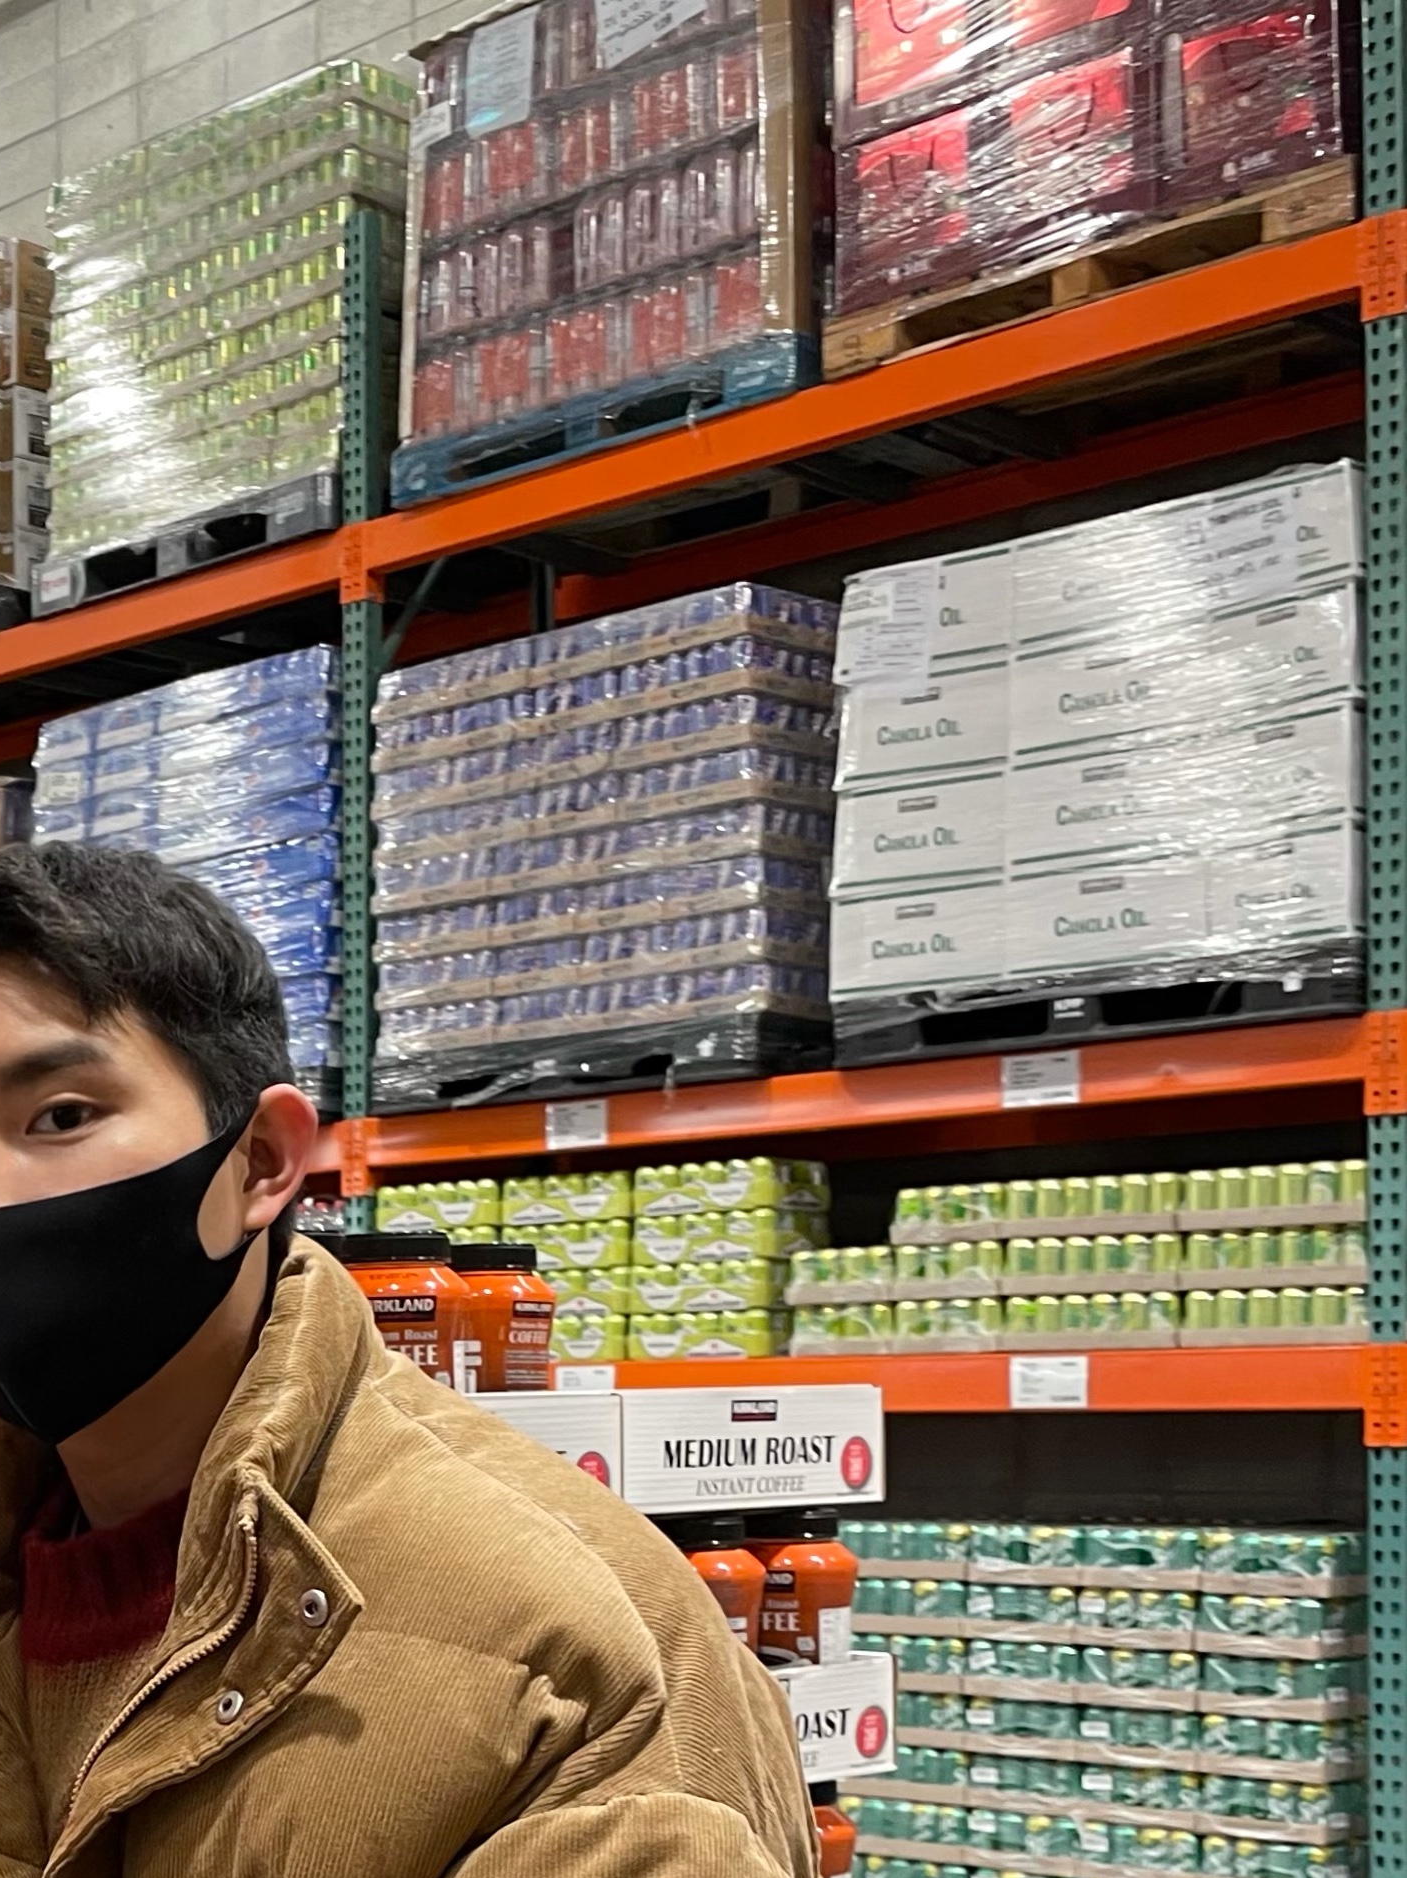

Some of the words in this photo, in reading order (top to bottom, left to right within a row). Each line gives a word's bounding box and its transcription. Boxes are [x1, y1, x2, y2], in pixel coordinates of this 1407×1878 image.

[663, 1438, 757, 1469] MEDIUM
[765, 1435, 836, 1466] ROAST
[695, 1477, 754, 1497] INSTANT
[756, 1475, 806, 1495] COFFEE
